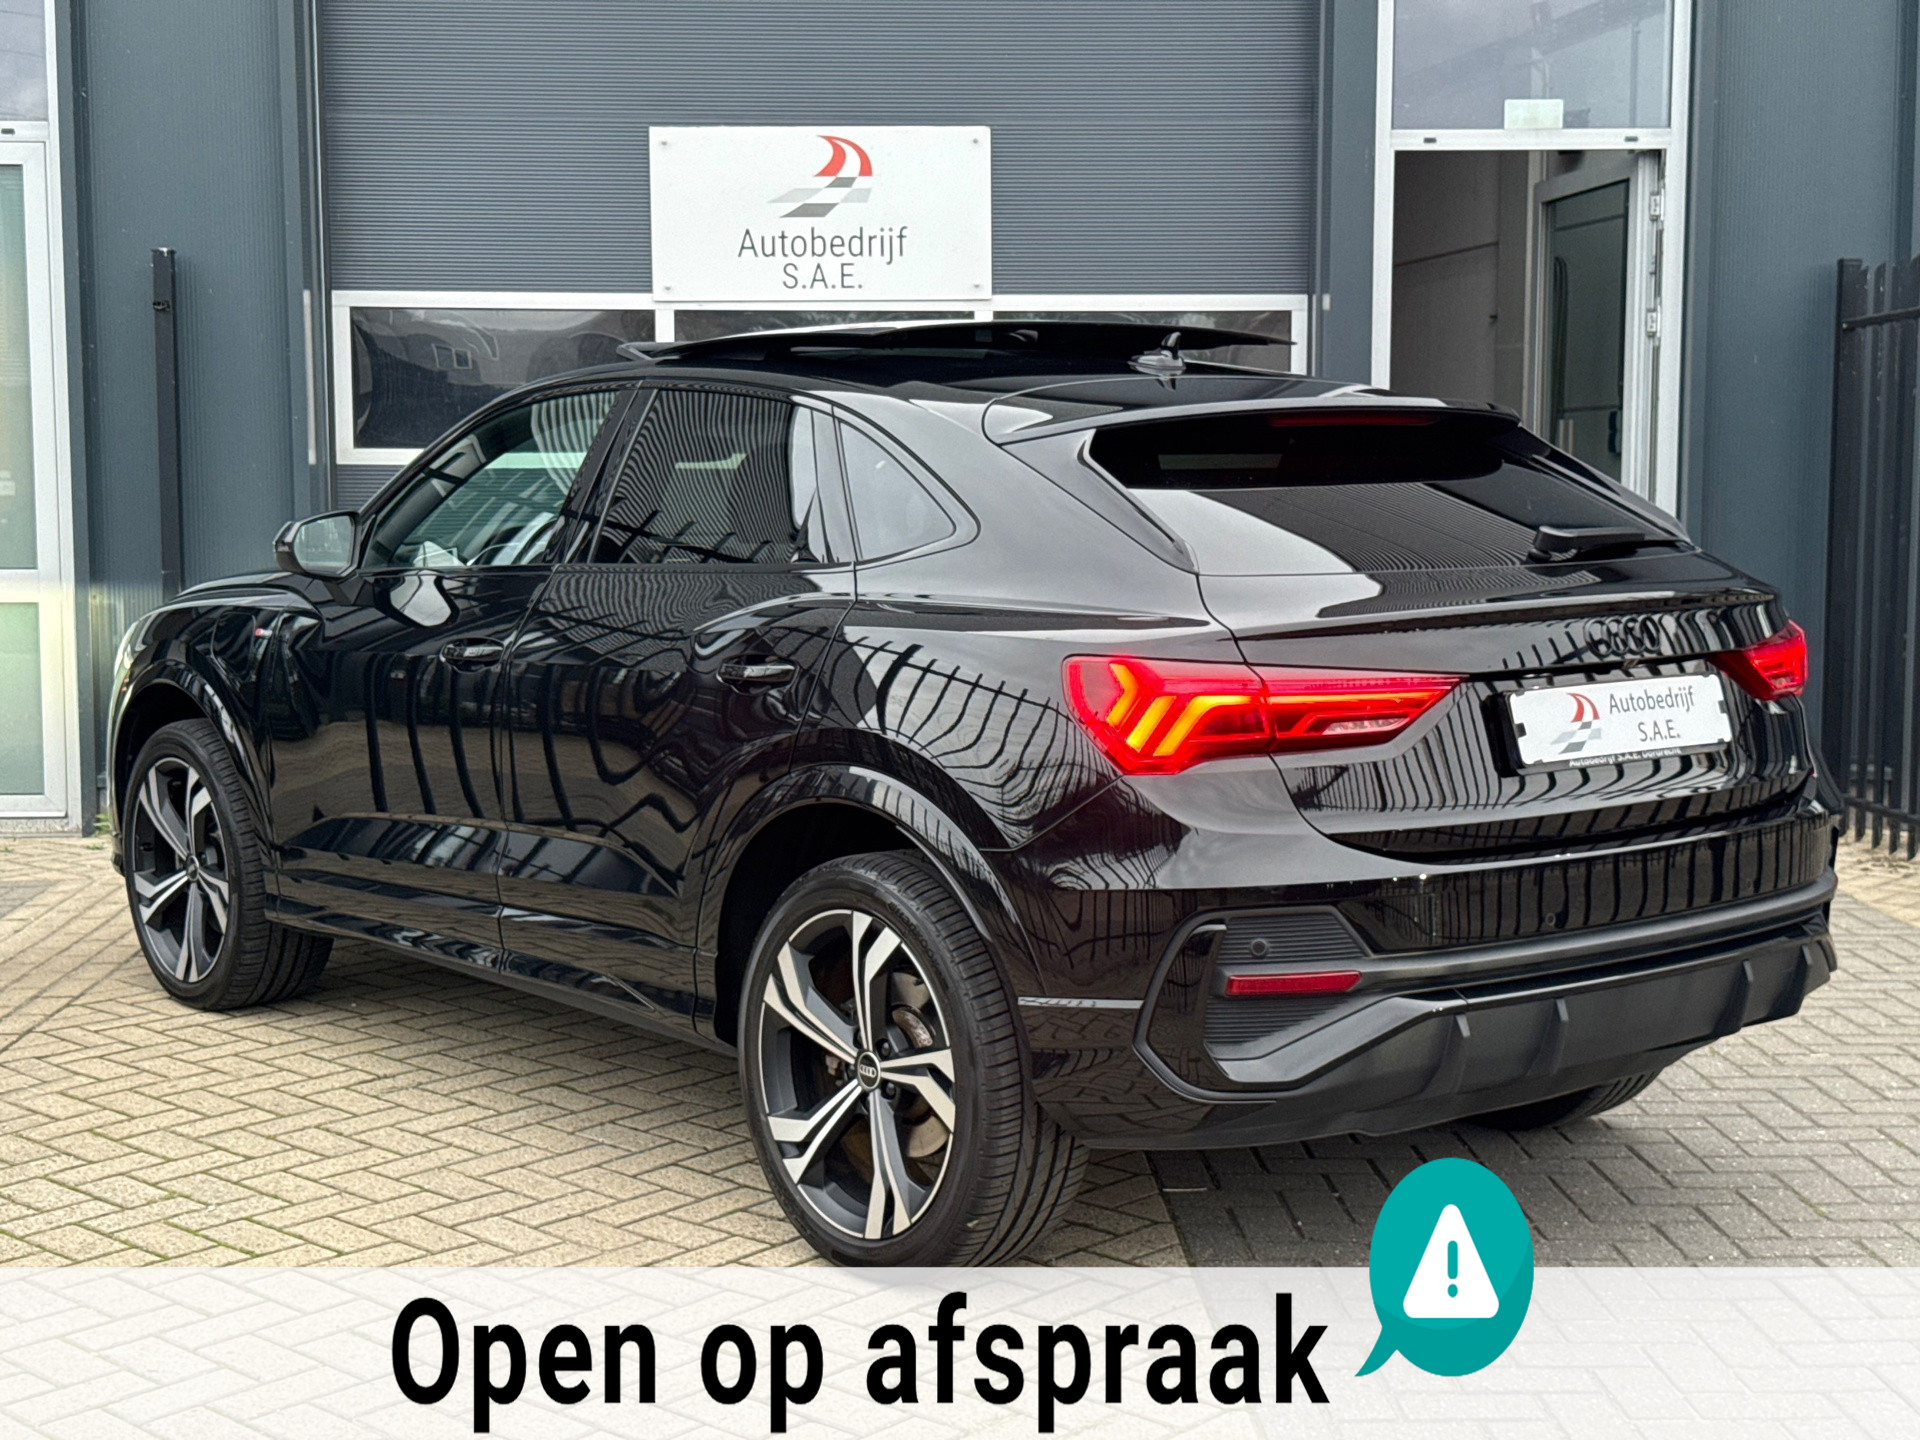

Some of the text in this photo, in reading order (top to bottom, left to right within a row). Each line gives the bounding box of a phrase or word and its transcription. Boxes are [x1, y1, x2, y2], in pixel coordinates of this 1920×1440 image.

[738, 226, 907, 265] Autobedrijf
[783, 263, 863, 289] S.A.E.
[1609, 685, 1694, 714] Autobedrijf
[1637, 719, 1681, 742] S.A.E.
